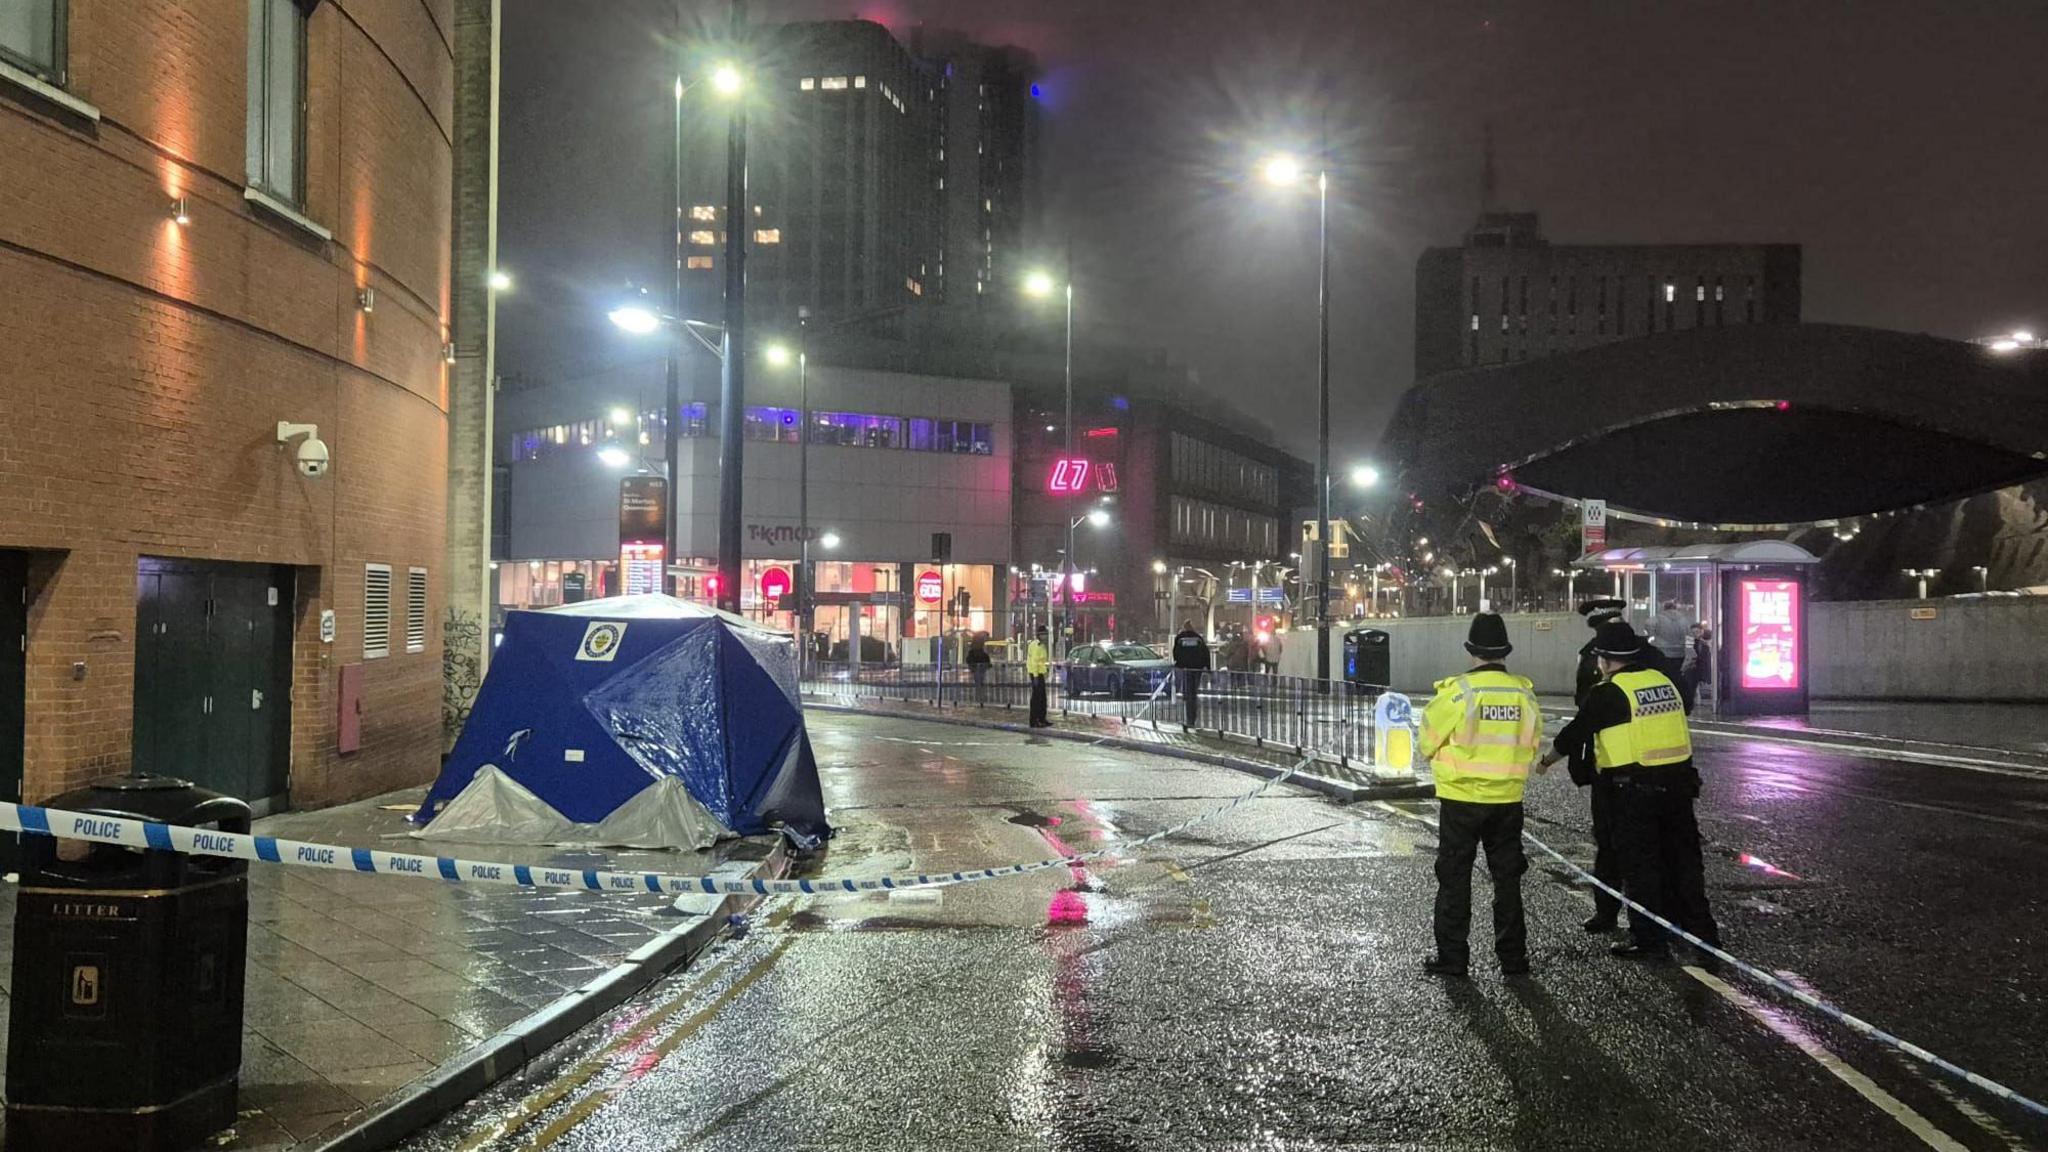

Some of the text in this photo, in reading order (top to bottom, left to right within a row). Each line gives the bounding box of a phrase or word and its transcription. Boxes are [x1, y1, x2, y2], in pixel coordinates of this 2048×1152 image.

[1636, 686, 1676, 704] POLICE
[1482, 706, 1520, 720] POLICE
[74, 818, 121, 839] POLICE
[193, 833, 235, 852] POLICE
[298, 846, 335, 864] POLICE
[390, 857, 422, 872] POLICE
[472, 865, 500, 879] POLICE
[545, 872, 570, 885] POLICE
[610, 876, 634, 888] POLICE
[670, 880, 692, 891] POLICE
[53, 903, 120, 916] LITTER
